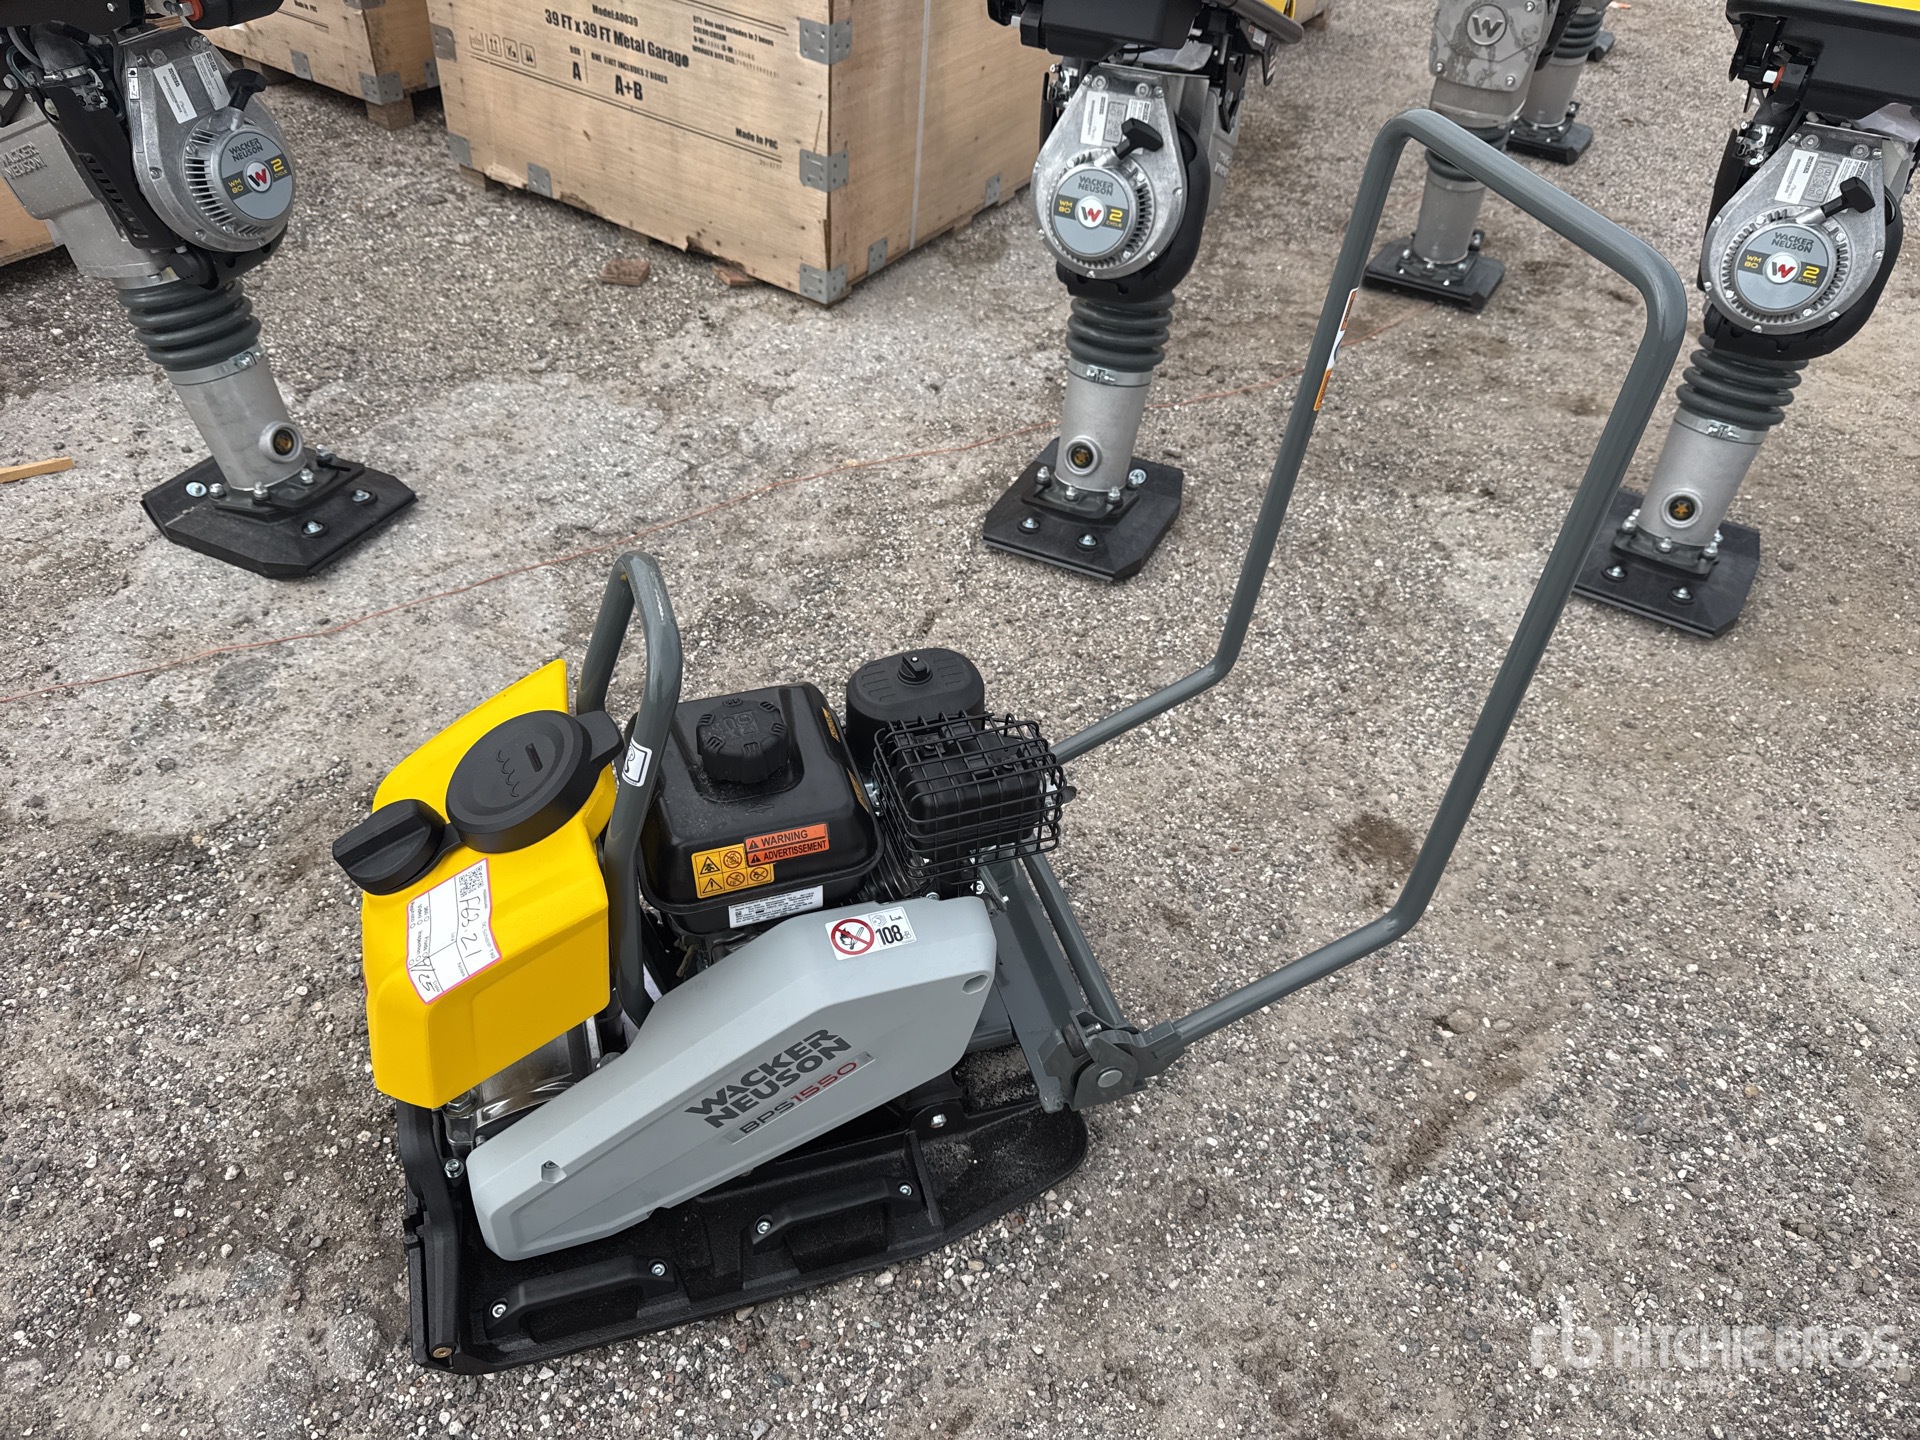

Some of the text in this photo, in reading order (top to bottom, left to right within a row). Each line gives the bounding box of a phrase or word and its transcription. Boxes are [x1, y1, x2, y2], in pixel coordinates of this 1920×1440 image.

[544, 9, 559, 26] 39
[561, 13, 572, 31] FT
[575, 20, 582, 34] x
[583, 21, 597, 39] 39
[600, 25, 611, 43] FT
[613, 30, 645, 54] Metal
[647, 41, 689, 68] Garage
[572, 61, 582, 81] A
[615, 74, 643, 101] A+B
[736, 127, 755, 142] Made
[756, 133, 763, 145] in
[229, 138, 259, 154] WACKER
[231, 145, 263, 162] NEUSON
[271, 158, 284, 172] 2
[228, 179, 242, 188] WM
[232, 185, 244, 194] 80
[1078, 182, 1113, 196] NEUSON
[1079, 175, 1114, 188] WACKER
[1058, 206, 1071, 214] 80
[1059, 200, 1073, 208] WM
[1109, 208, 1123, 222] 2
[1771, 238, 1814, 254] NEUSON
[1774, 231, 1815, 247] WACKER
[1744, 261, 1759, 269] 80
[1746, 254, 1762, 263] WM
[1802, 265, 1820, 279] 2
[761, 830, 808, 847] WARNING
[763, 840, 827, 861] ADVERTISSEMENT
[875, 924, 904, 946] 108
[684, 1029, 839, 1115] WACKER
[704, 1037, 852, 1129] NEUSON
[739, 1061, 857, 1134] BPS1550
